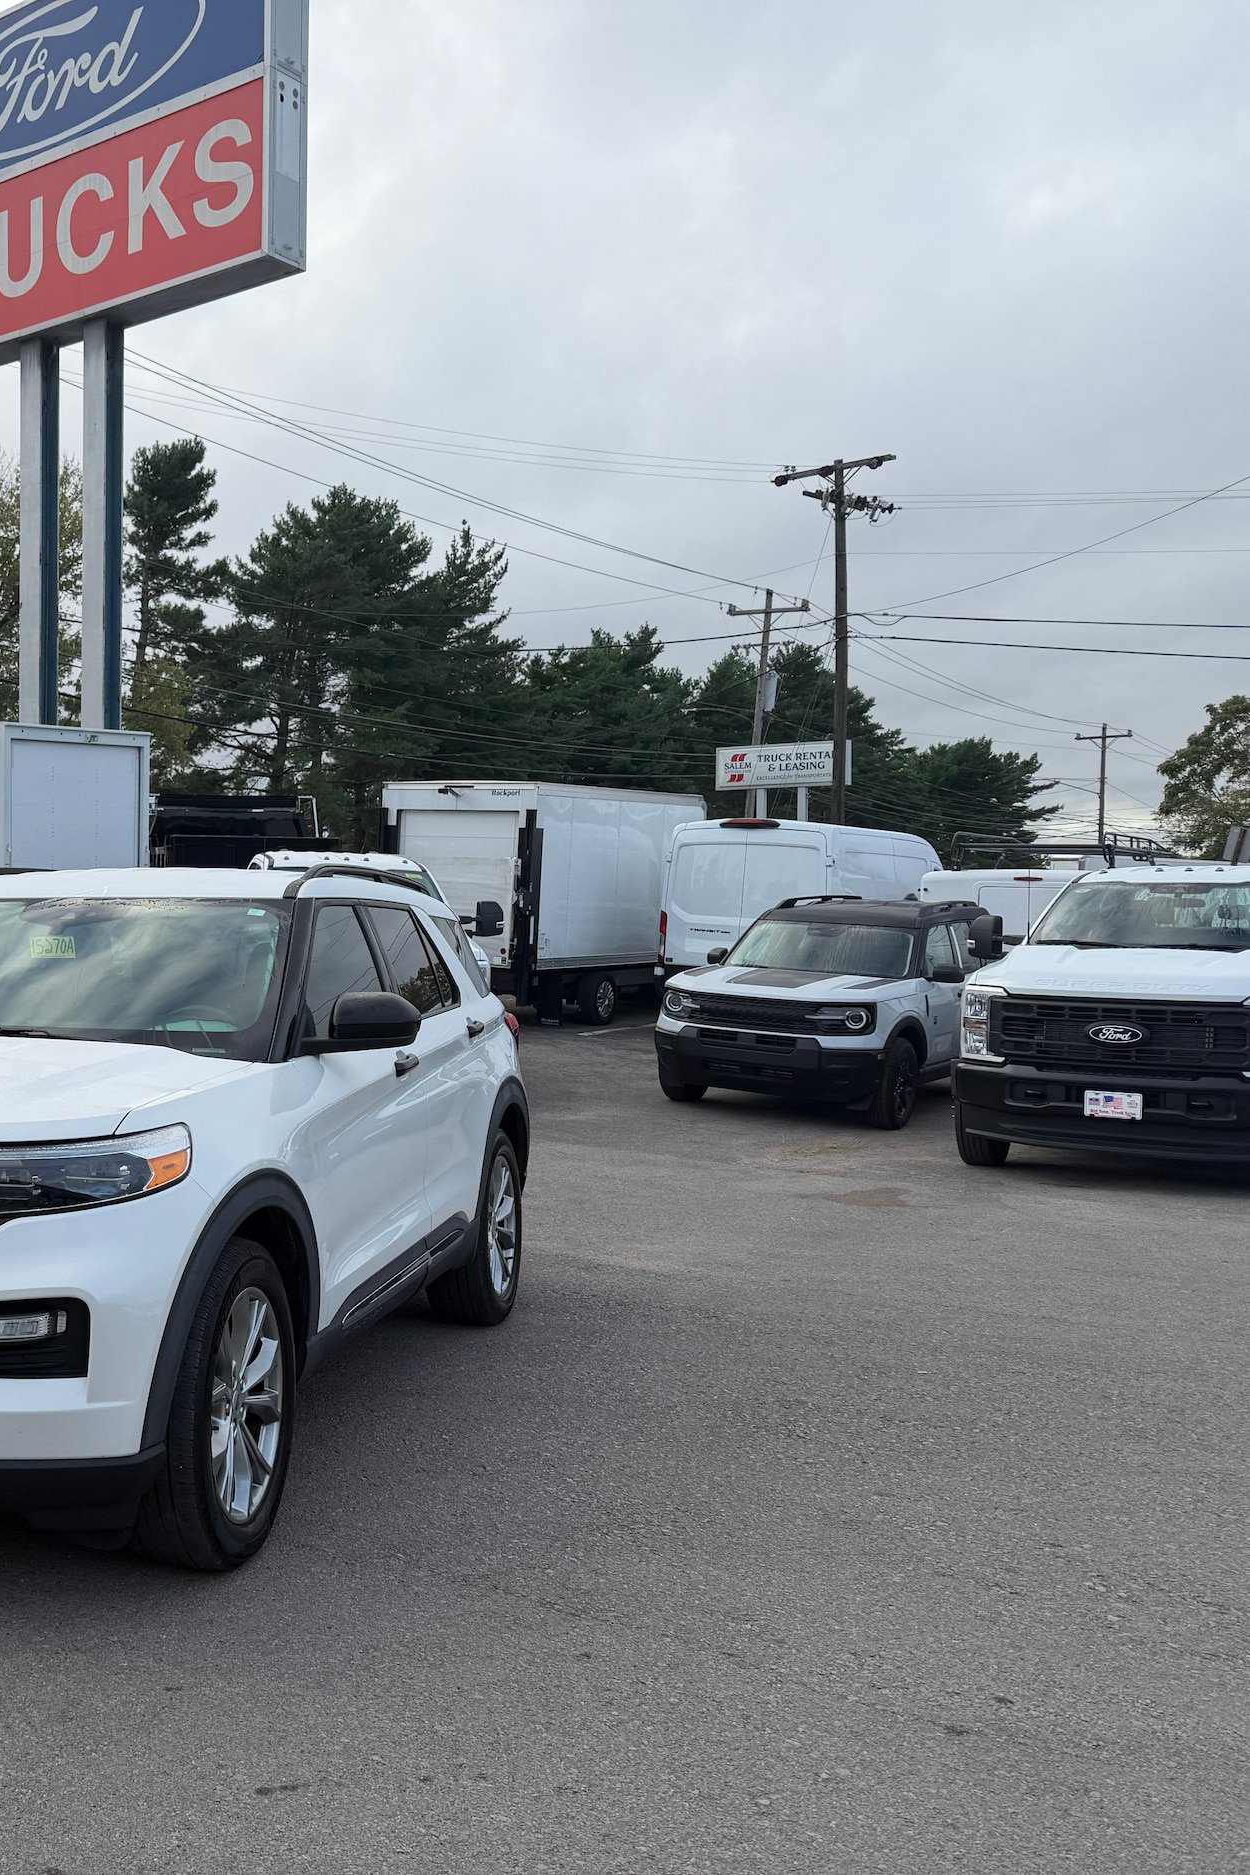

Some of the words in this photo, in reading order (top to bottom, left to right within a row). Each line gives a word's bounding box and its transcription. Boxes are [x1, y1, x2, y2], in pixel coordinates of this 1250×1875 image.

[757, 753, 792, 763] TRUCK
[724, 762, 752, 770] SALEM
[768, 763, 776, 772] &
[779, 761, 825, 771] LEASING
[491, 789, 521, 797] Rockport
[1034, 977, 1128, 990] SUPER
[1132, 982, 1212, 992] DUTY
[1098, 1027, 1132, 1041] Ford
